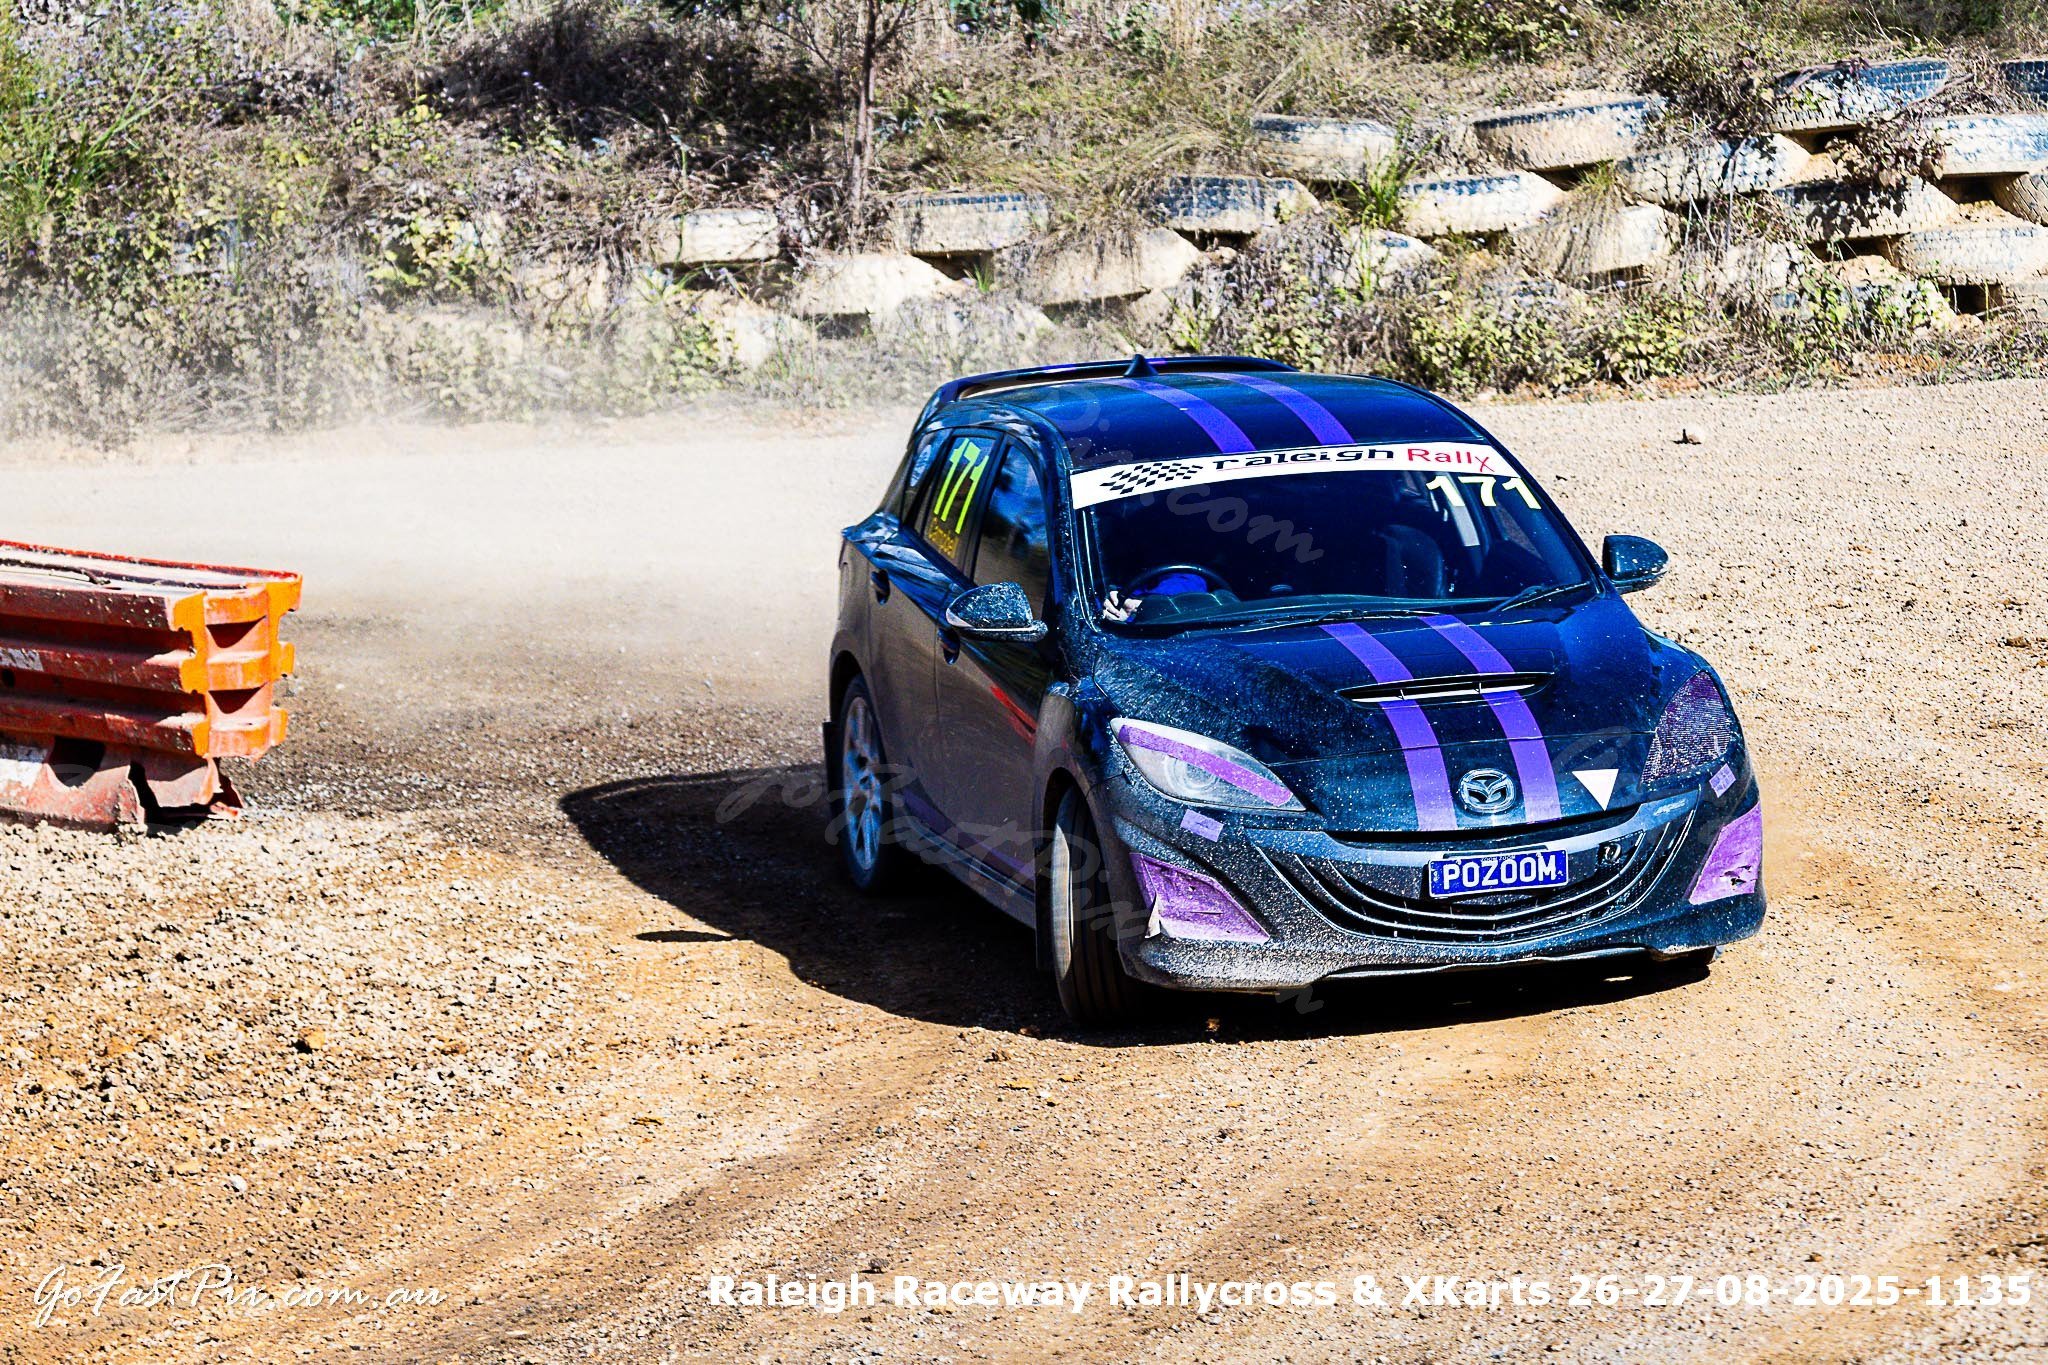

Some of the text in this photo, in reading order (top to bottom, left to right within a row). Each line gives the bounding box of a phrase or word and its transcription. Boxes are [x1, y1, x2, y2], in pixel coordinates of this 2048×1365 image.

[1213, 448, 1394, 470] raleigh
[934, 437, 989, 535] 171
[1425, 475, 1541, 510] 171
[1442, 854, 1557, 890] POZOOM
